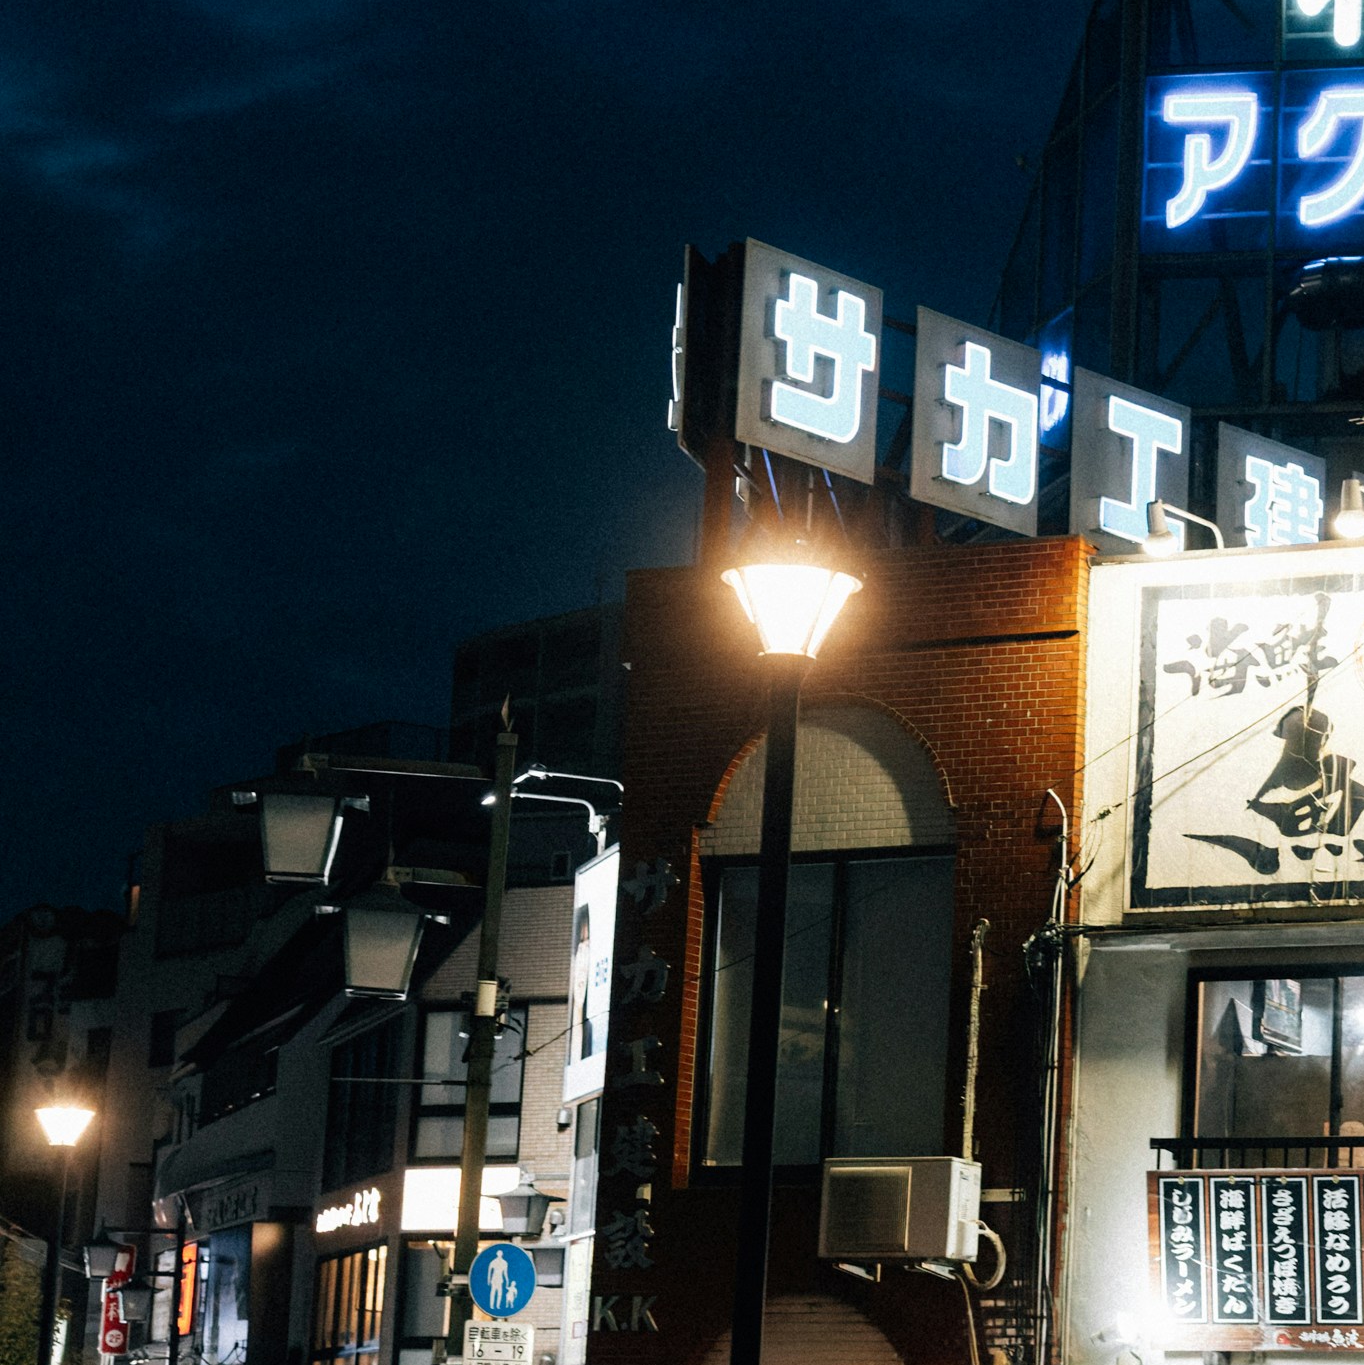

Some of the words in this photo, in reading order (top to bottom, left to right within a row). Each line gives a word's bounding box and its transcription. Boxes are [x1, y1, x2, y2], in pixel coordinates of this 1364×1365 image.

[1163, 592, 1338, 700] 海鮮
[1170, 1188, 1197, 1316] しじみラーメン
[1220, 1188, 1248, 1316] 海鮮ばくだん
[1272, 1188, 1301, 1316] さざえつぼ焼き
[469, 1326, 528, 1342] 自転車を除く
